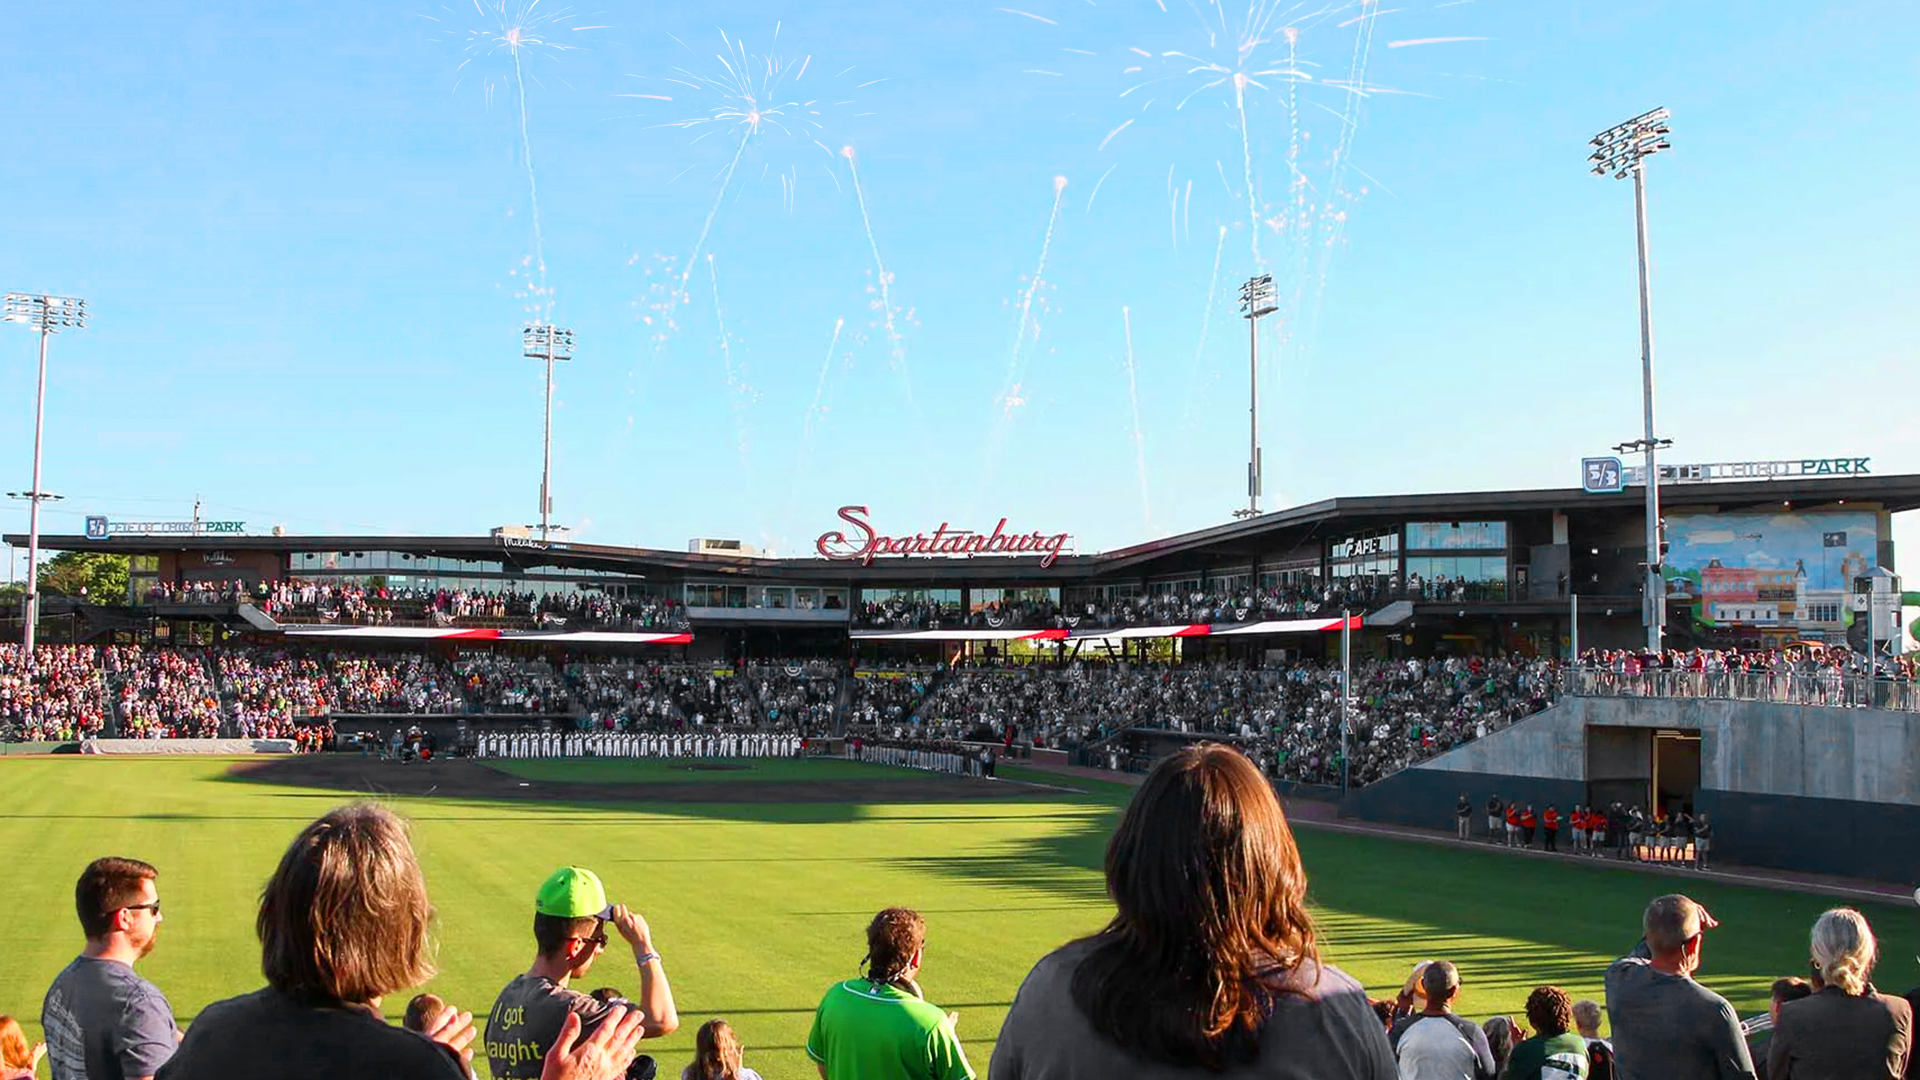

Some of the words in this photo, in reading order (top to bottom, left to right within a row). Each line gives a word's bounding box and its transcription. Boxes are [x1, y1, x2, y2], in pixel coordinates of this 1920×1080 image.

[1714, 460, 1790, 477] THIRD
[1801, 457, 1870, 475] PARK
[206, 522, 244, 532] PARK
[816, 505, 1068, 568] Spartanburg
[495, 1002, 503, 1023] I
[501, 1005, 525, 1030] got
